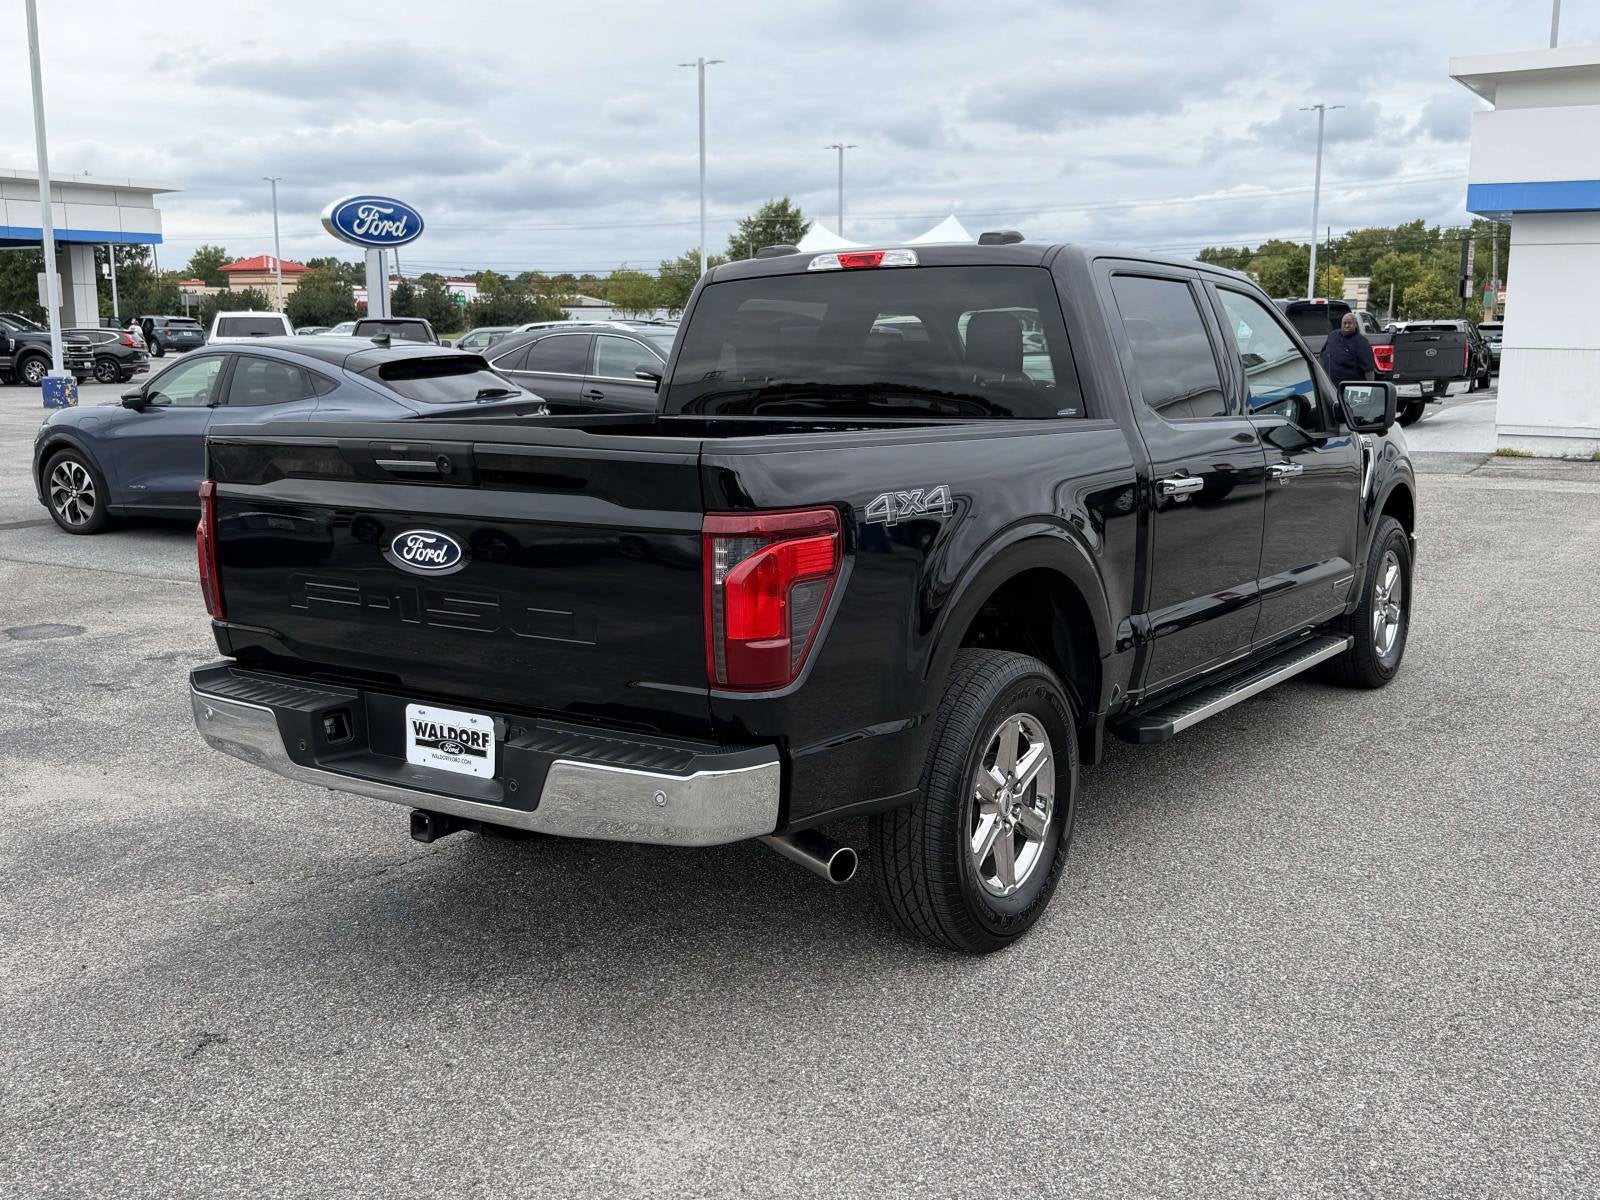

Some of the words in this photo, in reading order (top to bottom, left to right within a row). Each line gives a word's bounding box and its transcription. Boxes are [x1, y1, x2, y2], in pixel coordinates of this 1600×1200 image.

[353, 205, 407, 237] Ford
[403, 535, 448, 563] Ford
[412, 720, 490, 749] WALDORF
[443, 743, 460, 754] Ford
